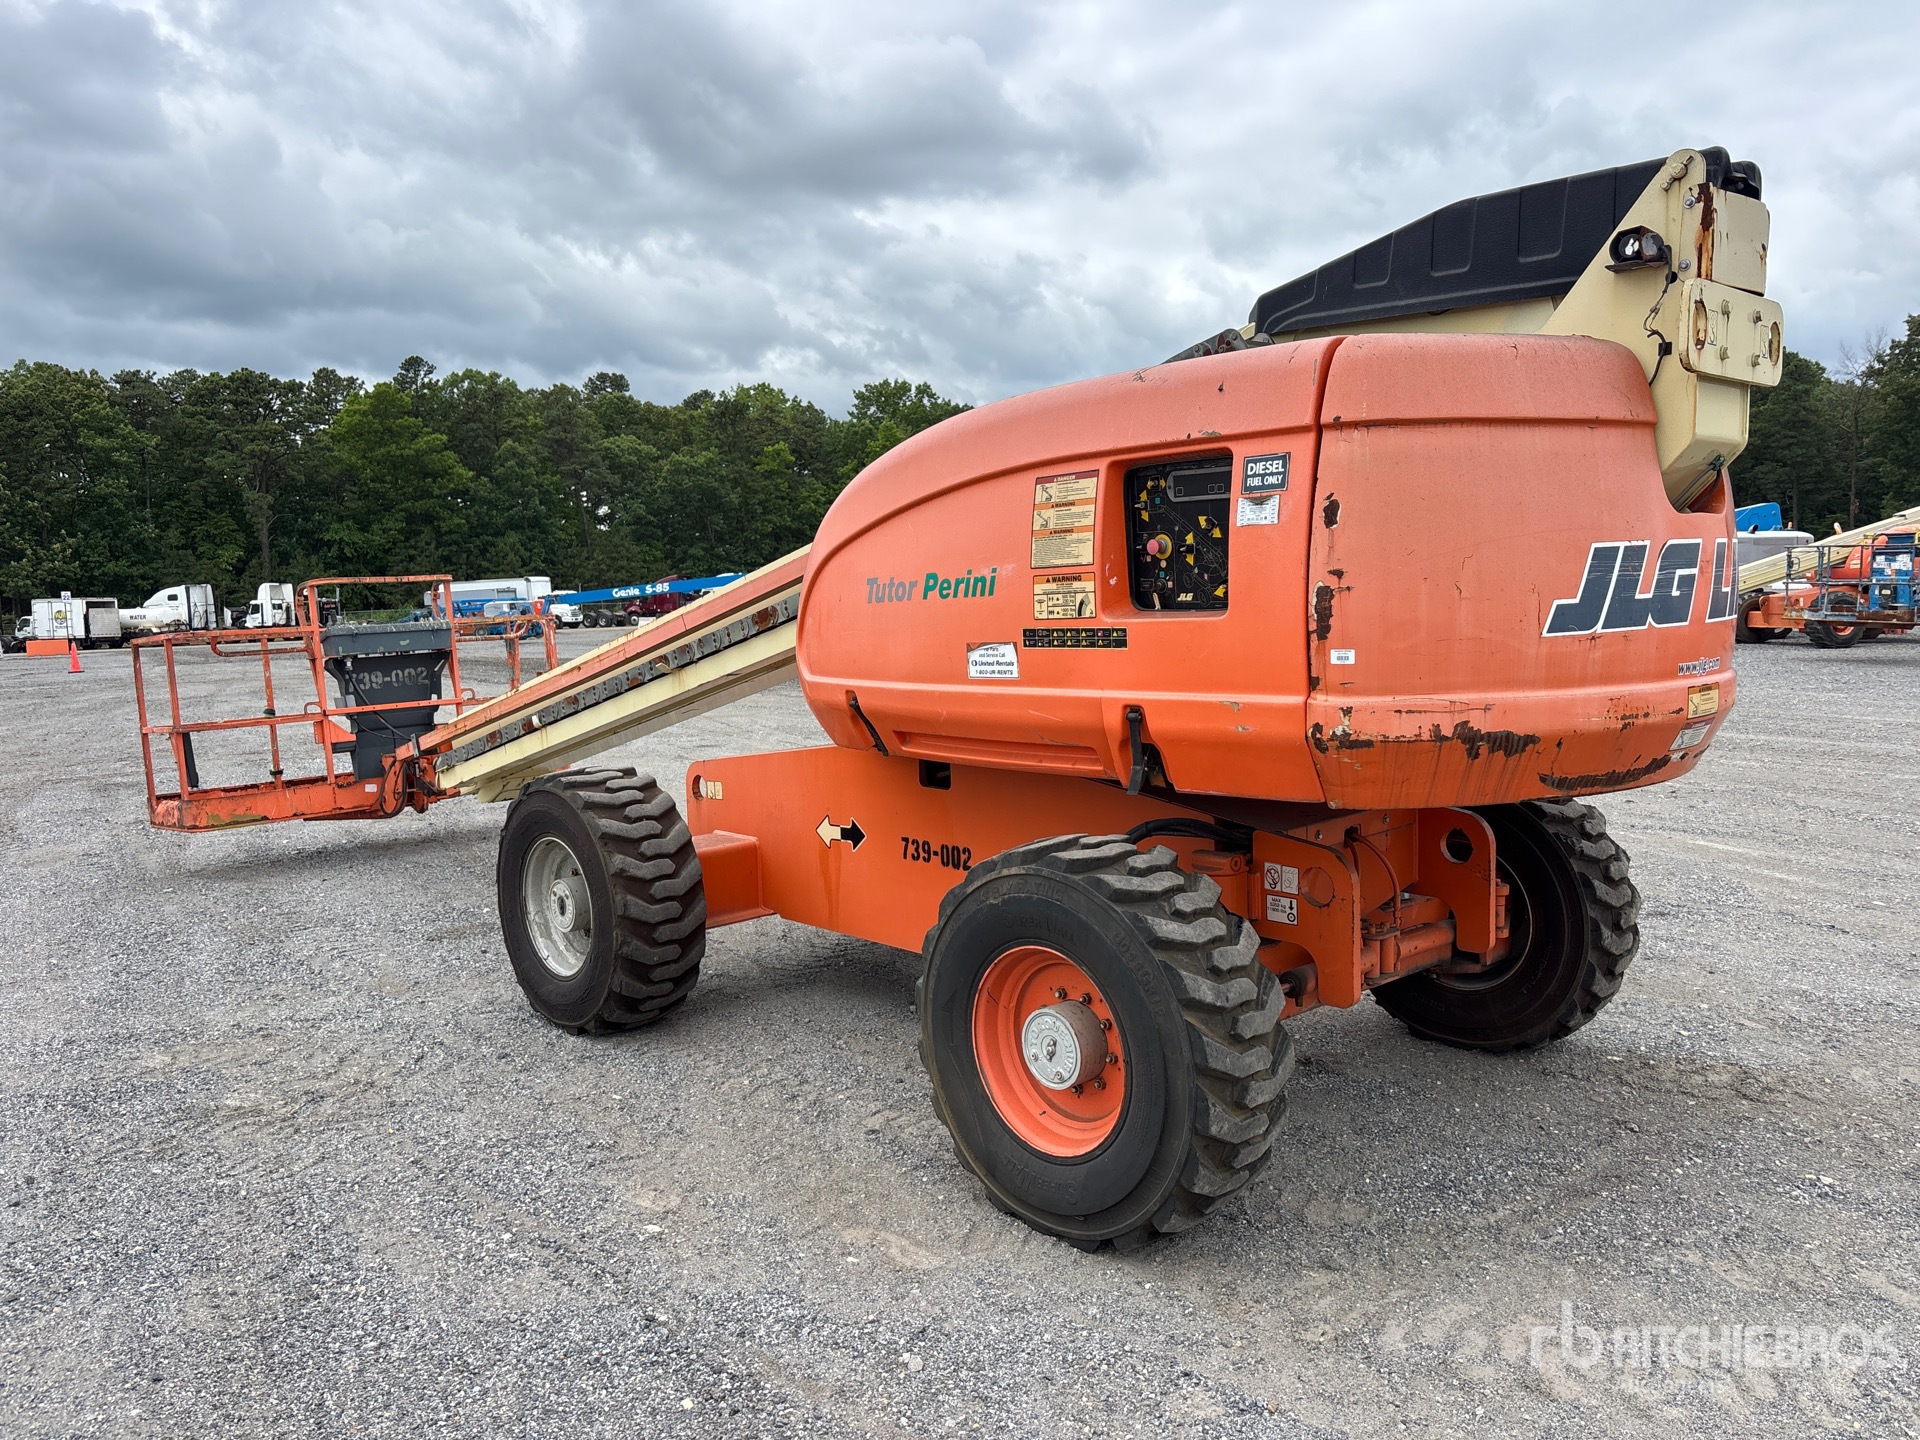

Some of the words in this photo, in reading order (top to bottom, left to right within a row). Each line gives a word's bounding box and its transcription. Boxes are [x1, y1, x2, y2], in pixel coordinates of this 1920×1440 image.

[1247, 460, 1285, 475] DIESEL
[1247, 477, 1263, 487] FUEL
[1264, 474, 1283, 485] ONLY
[866, 577, 918, 604] Tutor
[922, 567, 998, 600] Perini
[1051, 575, 1082, 583] WARNING
[612, 587, 641, 598] Genie
[645, 582, 670, 594] S-85
[1541, 538, 1703, 637] JLG
[1178, 593, 1194, 601] JLG
[1678, 657, 1720, 676] www.jlg.com
[901, 836, 972, 872] 739-002
